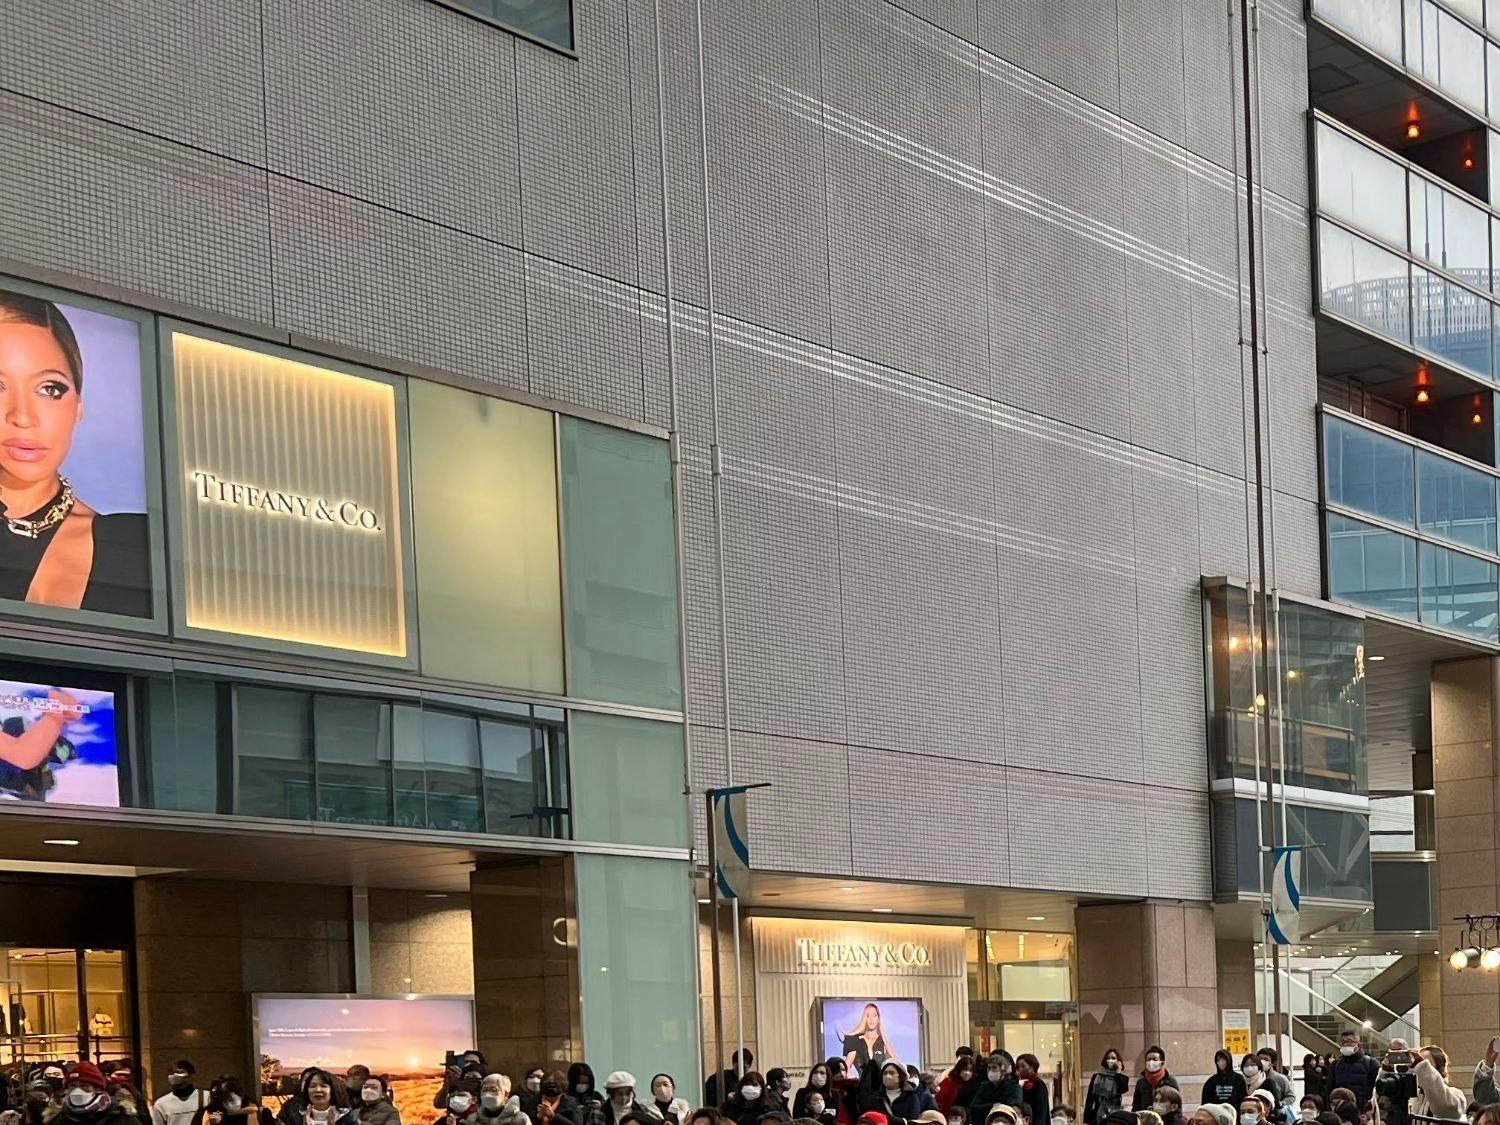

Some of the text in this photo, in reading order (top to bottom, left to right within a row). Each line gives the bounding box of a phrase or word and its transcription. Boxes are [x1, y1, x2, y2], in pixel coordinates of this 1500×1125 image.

[194, 471, 310, 518] TIFFANY
[315, 499, 336, 522] &
[800, 938, 881, 963] TIFFANY
[885, 943, 898, 963] &
